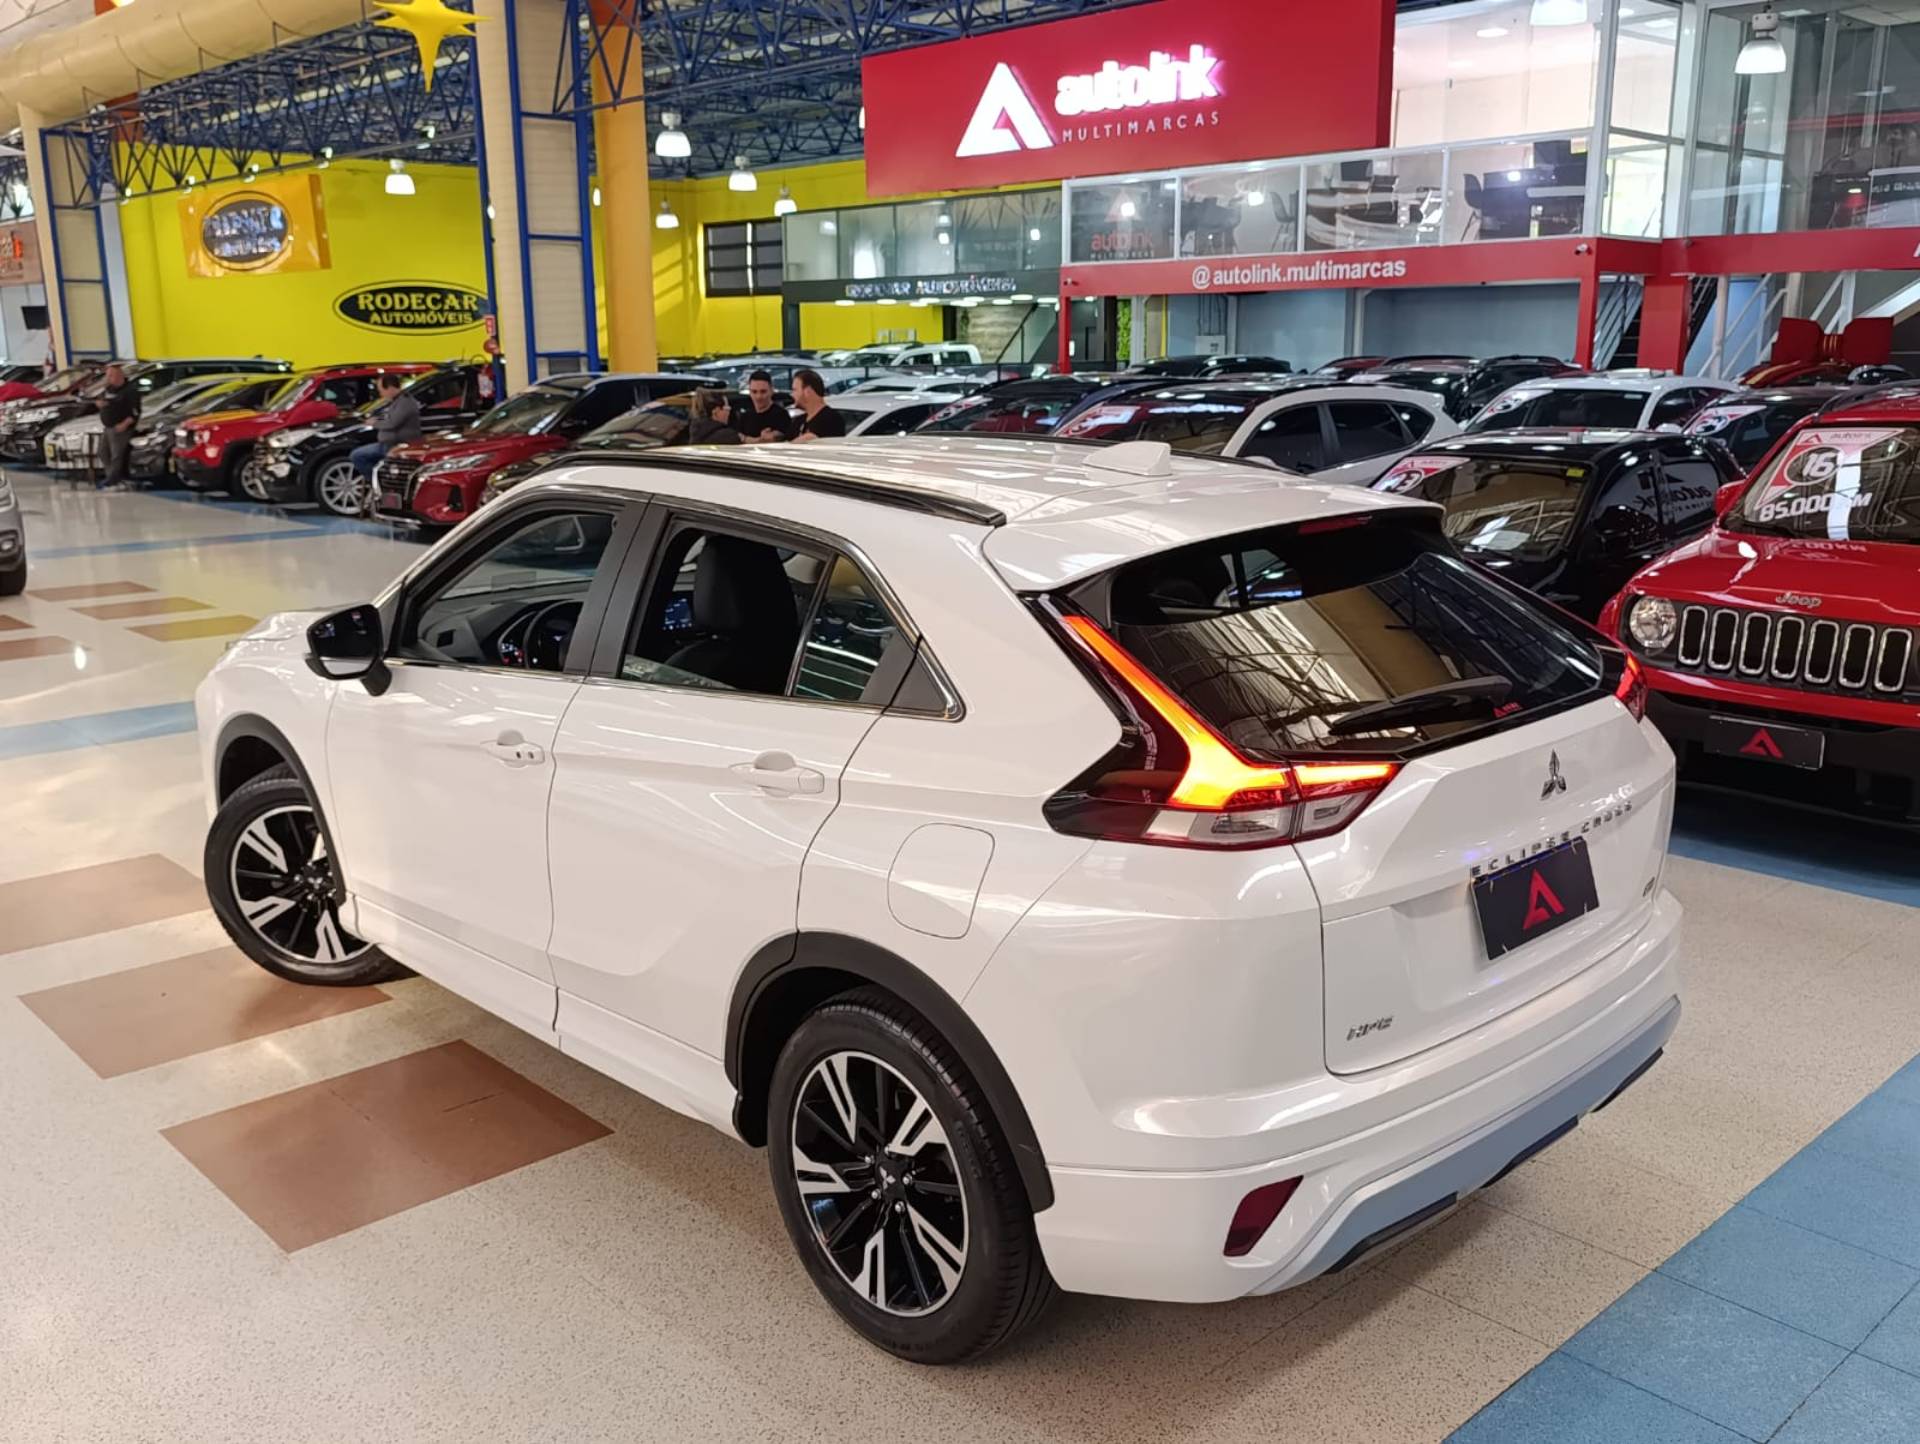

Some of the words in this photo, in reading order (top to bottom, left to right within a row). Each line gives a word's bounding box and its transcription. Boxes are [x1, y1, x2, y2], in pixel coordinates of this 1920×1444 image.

[1055, 44, 1219, 115] autolink
[1062, 111, 1220, 142] MULTIMARCAS
[1191, 260, 1407, 290] @autolink.multimarcas
[358, 292, 479, 312] RODECAR
[370, 310, 474, 325] AUTOMÓVEIS
[1802, 451, 1837, 478] 16
[1775, 591, 1822, 609] Jeep
[1471, 831, 1570, 876] ECLIPSE
